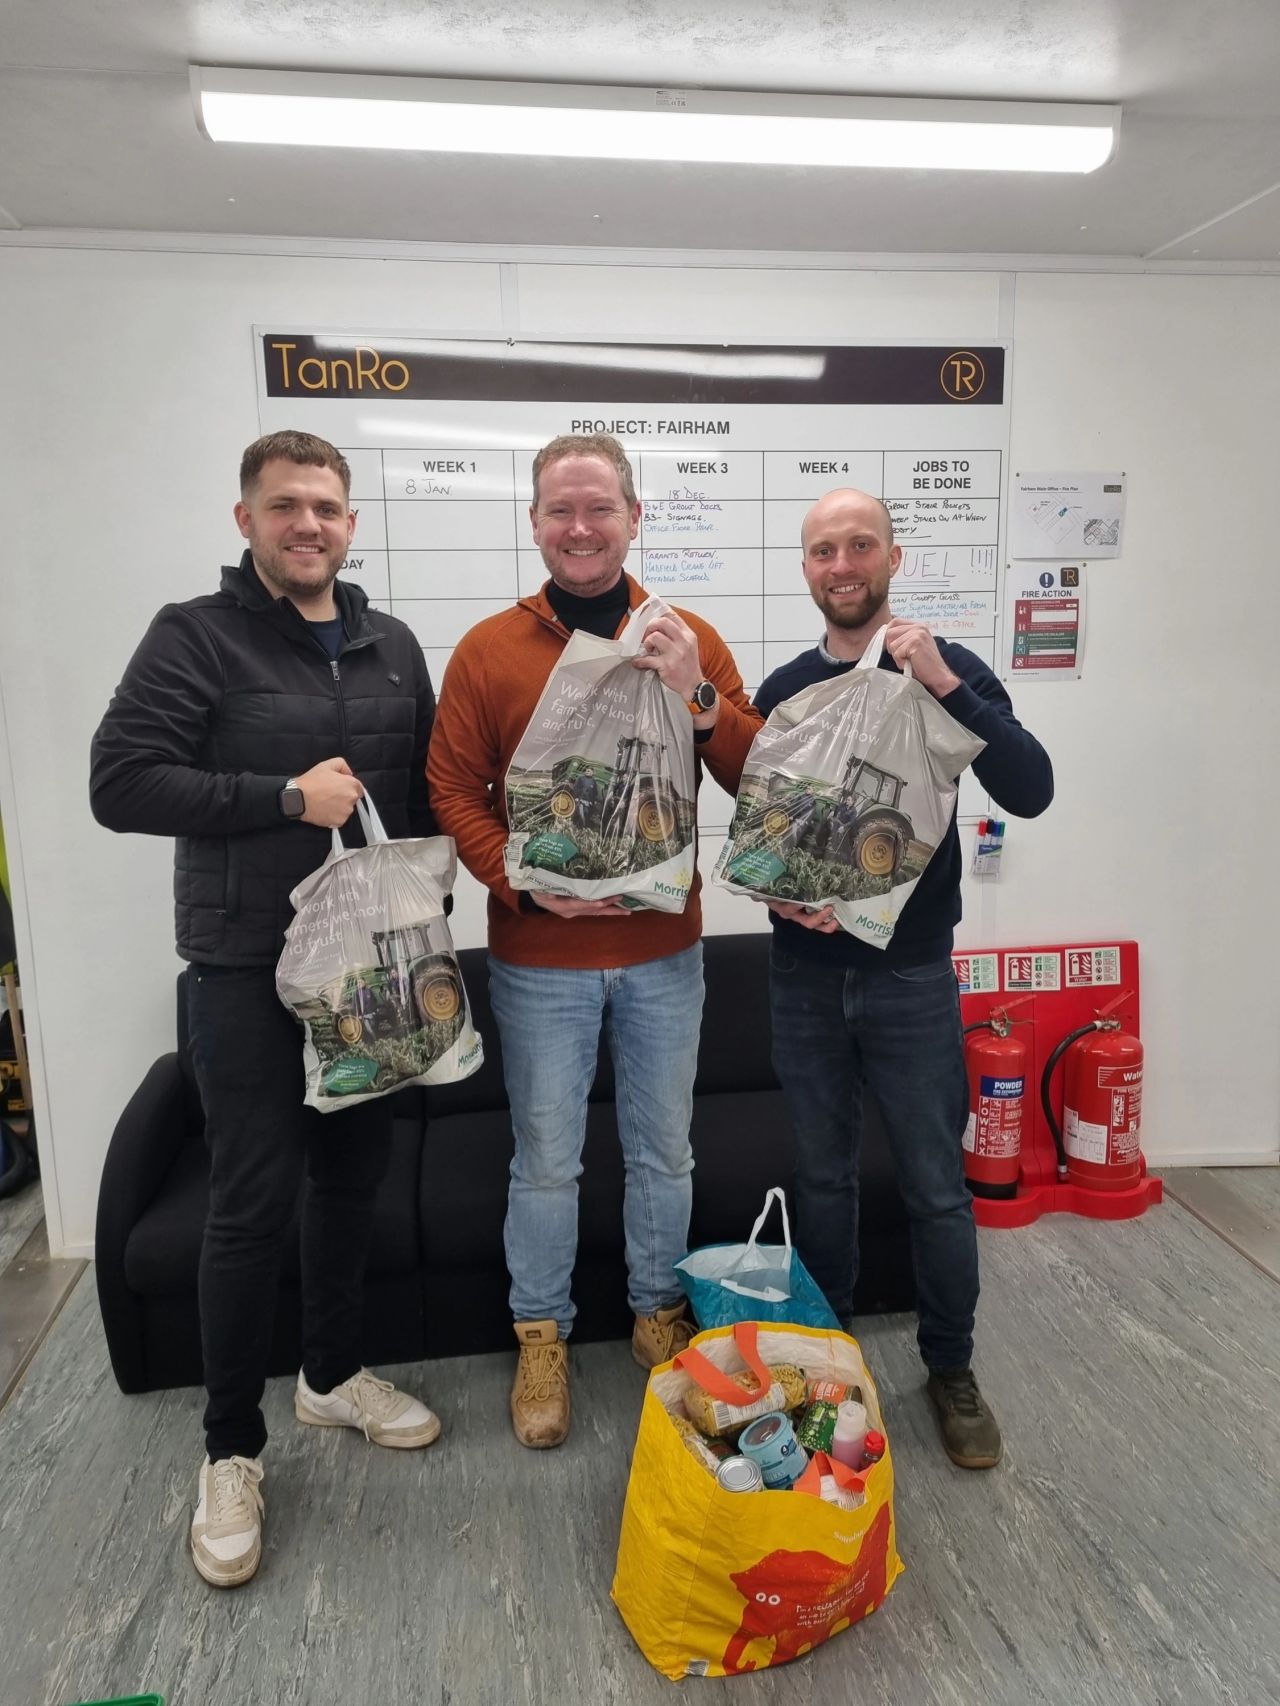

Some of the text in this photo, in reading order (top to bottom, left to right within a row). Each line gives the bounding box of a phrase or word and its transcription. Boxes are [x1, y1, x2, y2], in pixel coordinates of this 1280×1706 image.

[272, 343, 410, 391] TanRo
[571, 420, 731, 435] PROJECT: FAIRHAM
[423, 461, 477, 473] WEEK 1
[677, 462, 729, 474] WEEK 3
[799, 462, 850, 474] WEEK 4
[913, 461, 970, 473] JOBS TO
[405, 479, 416, 495] 8
[913, 478, 972, 490] BE DONE
[669, 490, 681, 500] 18
[891, 516, 909, 524] WEEP
[903, 551, 957, 578] UEL
[1021, 589, 1072, 598] FIRE ACTION
[994, 1081, 1022, 1090] POWDER
